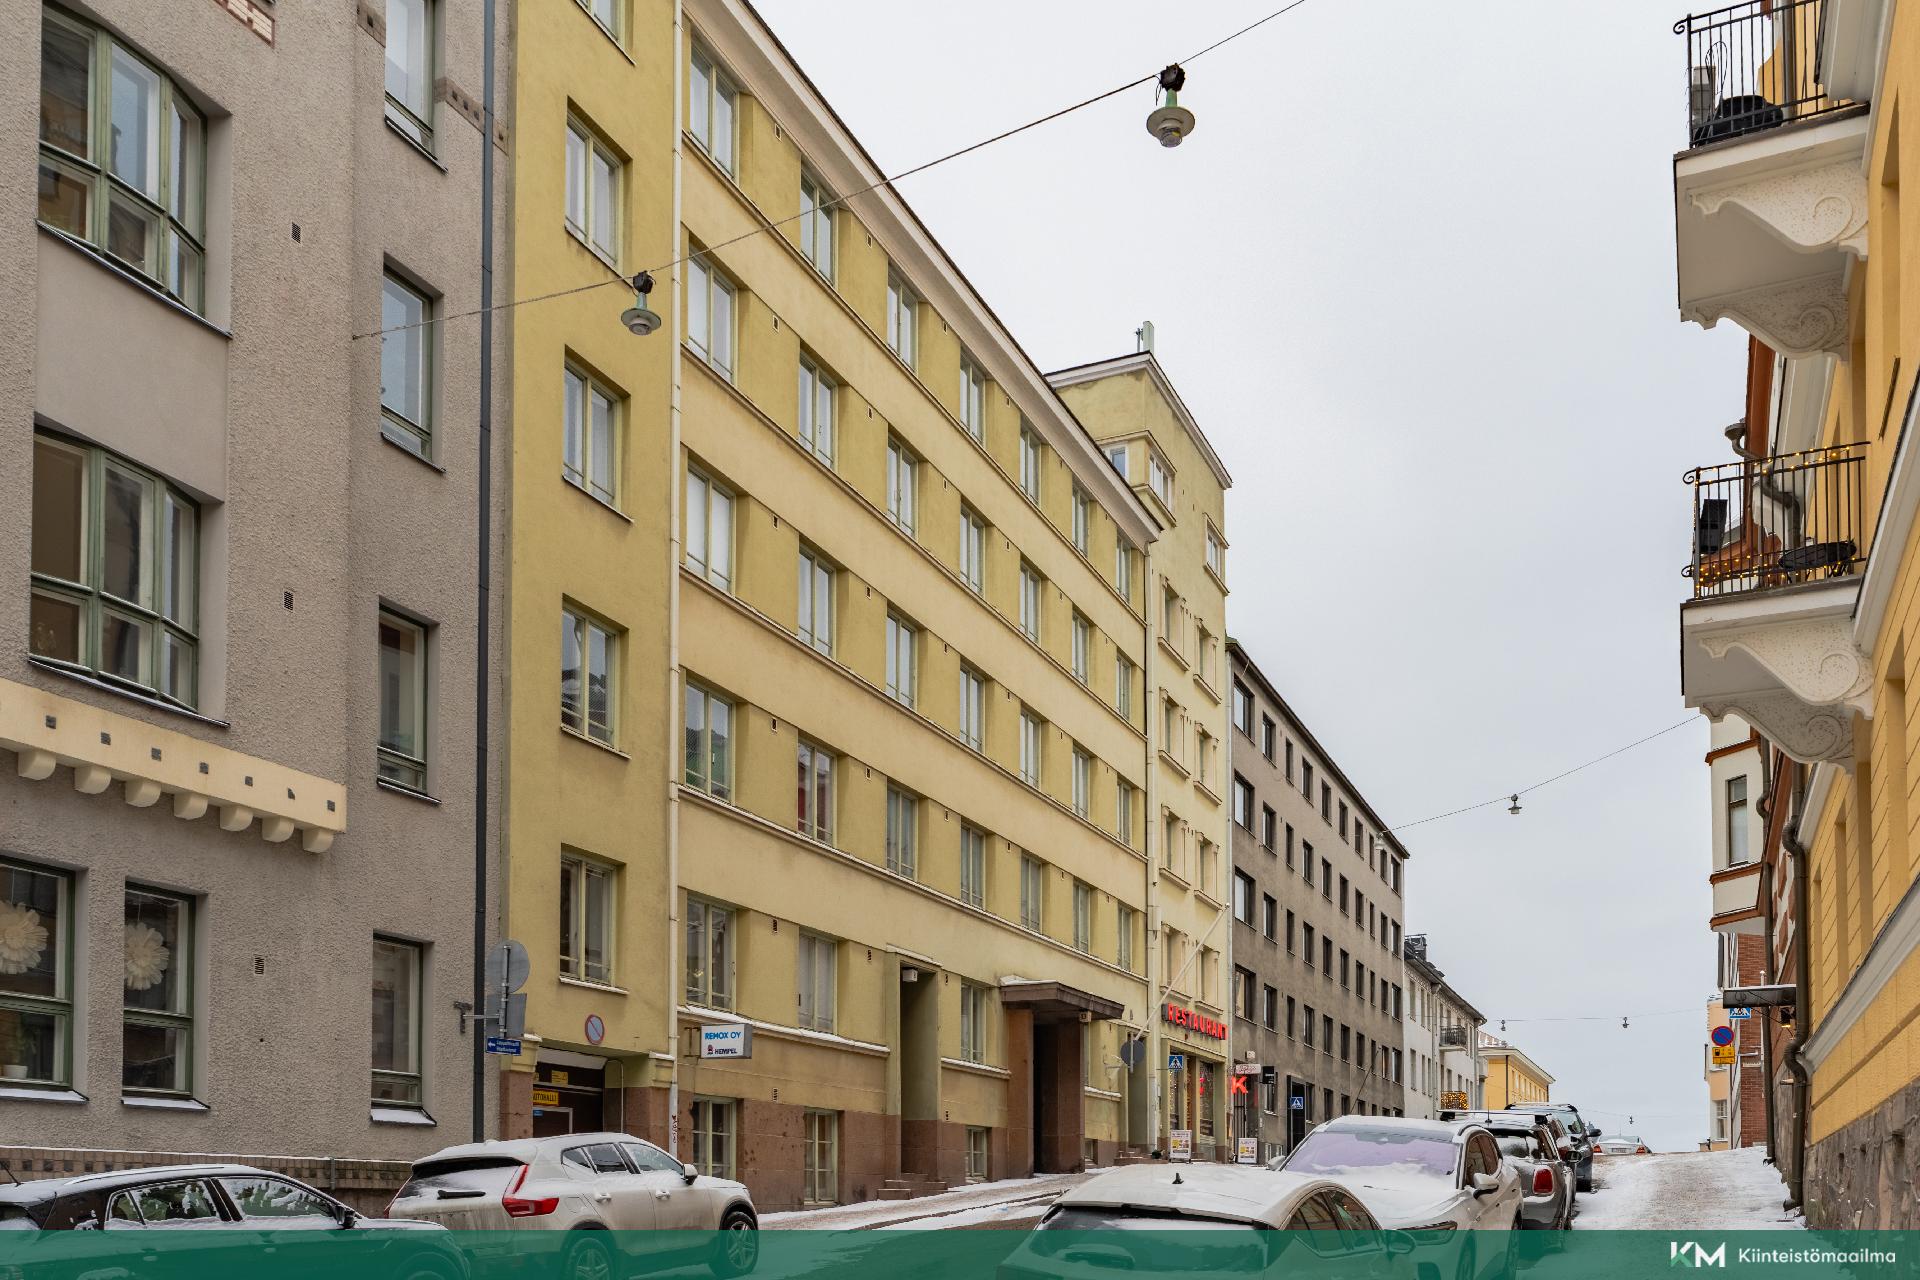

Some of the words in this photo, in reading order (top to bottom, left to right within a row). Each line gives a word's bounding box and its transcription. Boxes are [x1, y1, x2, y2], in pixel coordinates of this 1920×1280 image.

[1168, 1003, 1228, 1040] RESTAURANT
[704, 1032, 729, 1040] REMOX
[730, 1031, 742, 1039] OY
[1231, 1075, 1249, 1094] K
